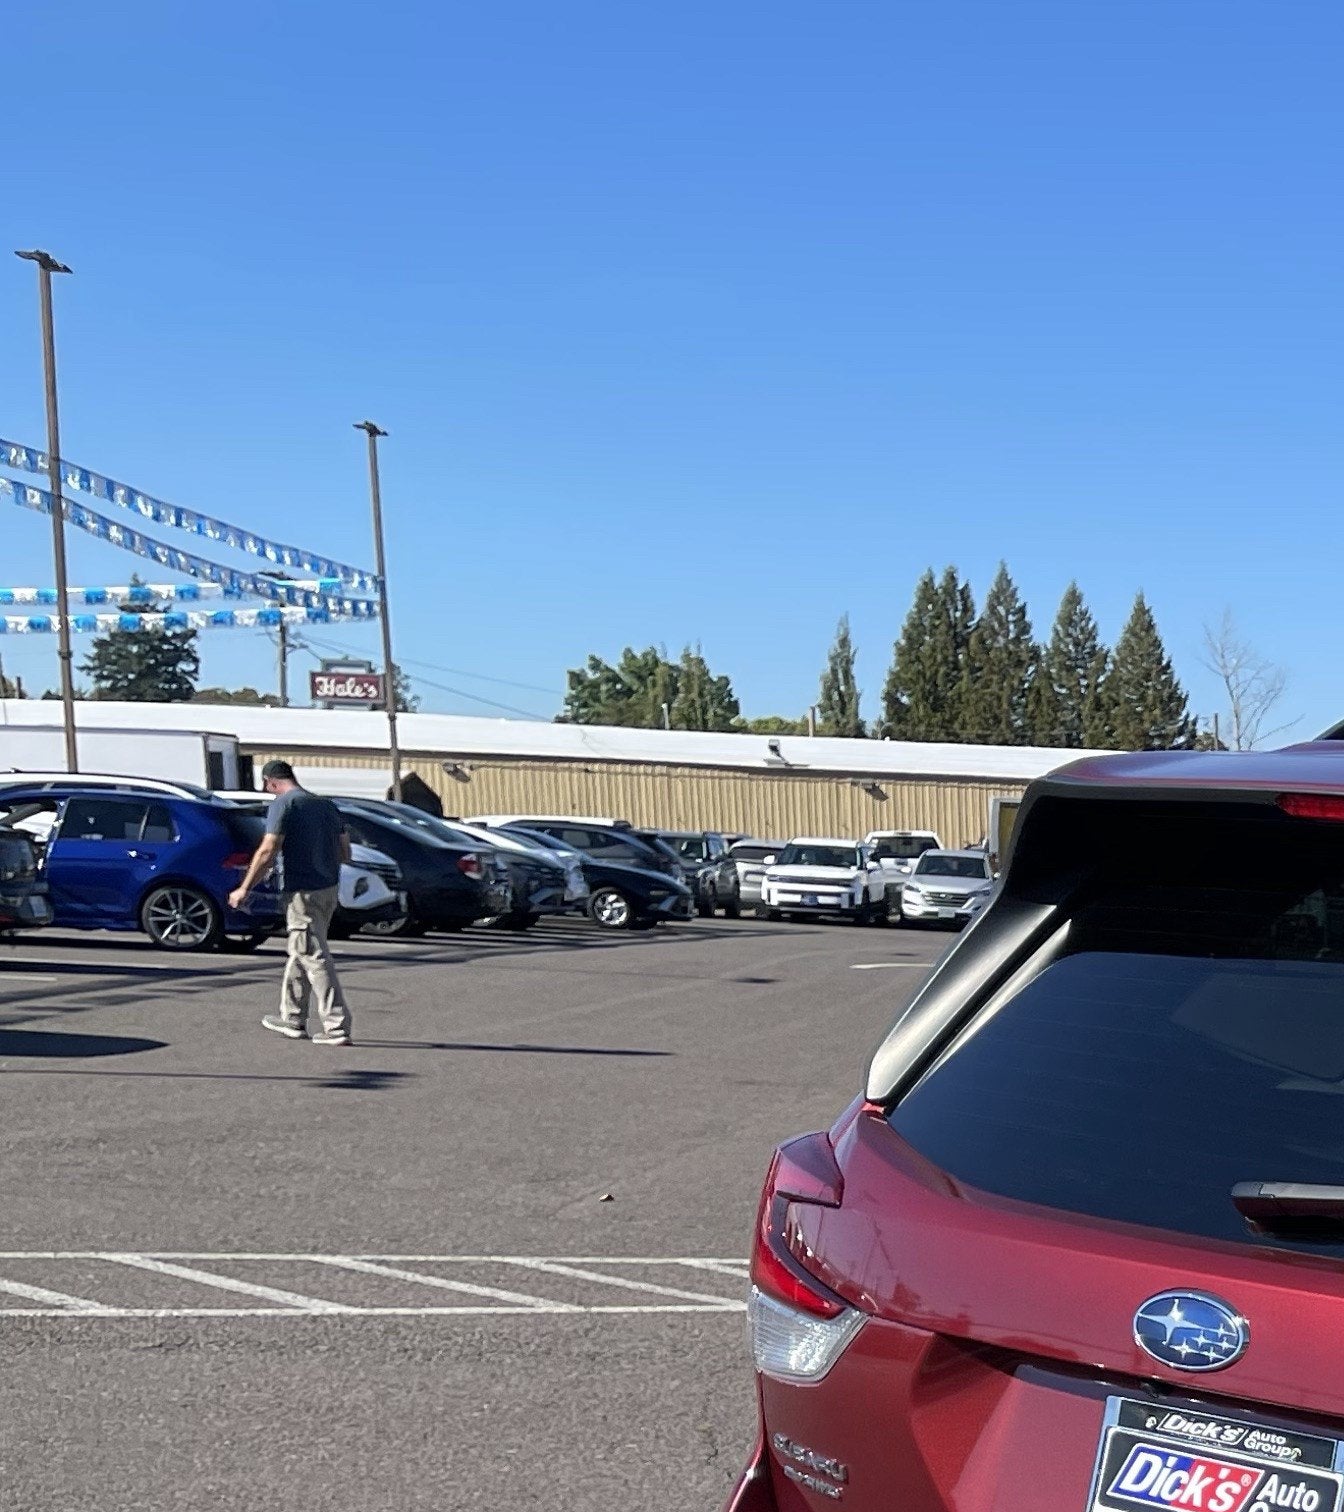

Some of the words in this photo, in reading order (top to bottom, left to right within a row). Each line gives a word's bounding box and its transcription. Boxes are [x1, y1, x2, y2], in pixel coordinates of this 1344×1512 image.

[315, 676, 378, 698] Hale's
[1163, 1414, 1244, 1442] Dick's
[1250, 1430, 1287, 1445] Auto
[1244, 1438, 1291, 1458] Group
[1119, 1451, 1241, 1512] Dick's
[1256, 1474, 1319, 1512] Auto
